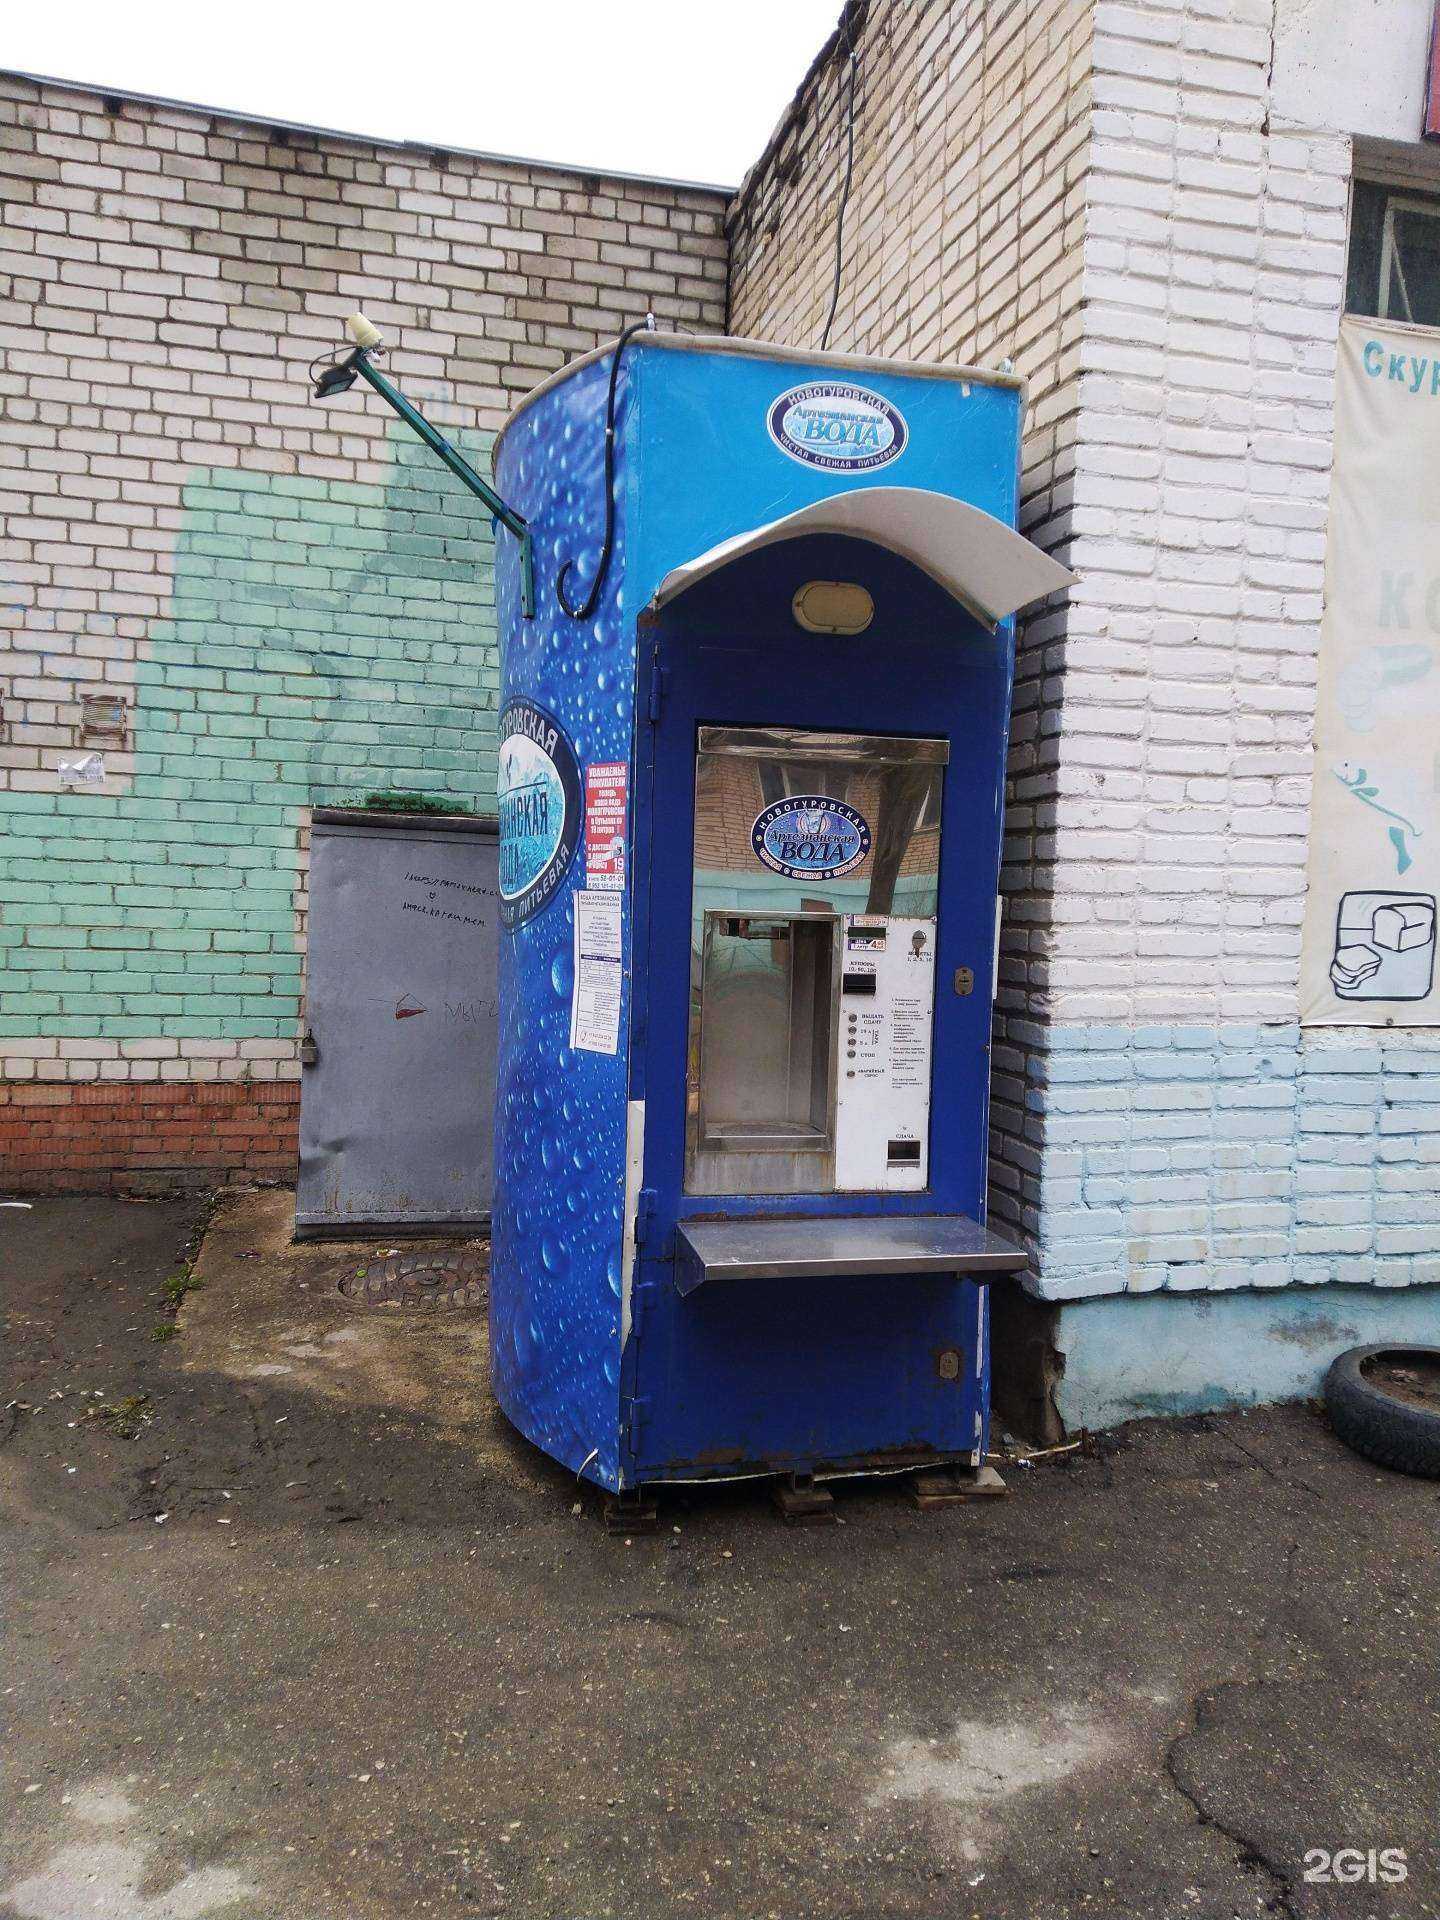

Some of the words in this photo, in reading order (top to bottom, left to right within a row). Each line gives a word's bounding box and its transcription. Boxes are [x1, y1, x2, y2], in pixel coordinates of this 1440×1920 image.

[787, 386, 891, 416] НОВОГУРОВСКАЯ
[780, 432, 809, 460] ЧИСТАЯ
[804, 418, 880, 447] ВОДА
[815, 455, 851, 469] СВЕЖАЯ
[858, 444, 899, 469] ПИТЬЕВАЯ
[759, 800, 866, 833] НОВОГУРОВСКАЯ
[768, 829, 855, 843] Артезианская
[780, 841, 846, 862] ВОДА
[519, 843, 570, 917] ПИТЬЕВАЯ
